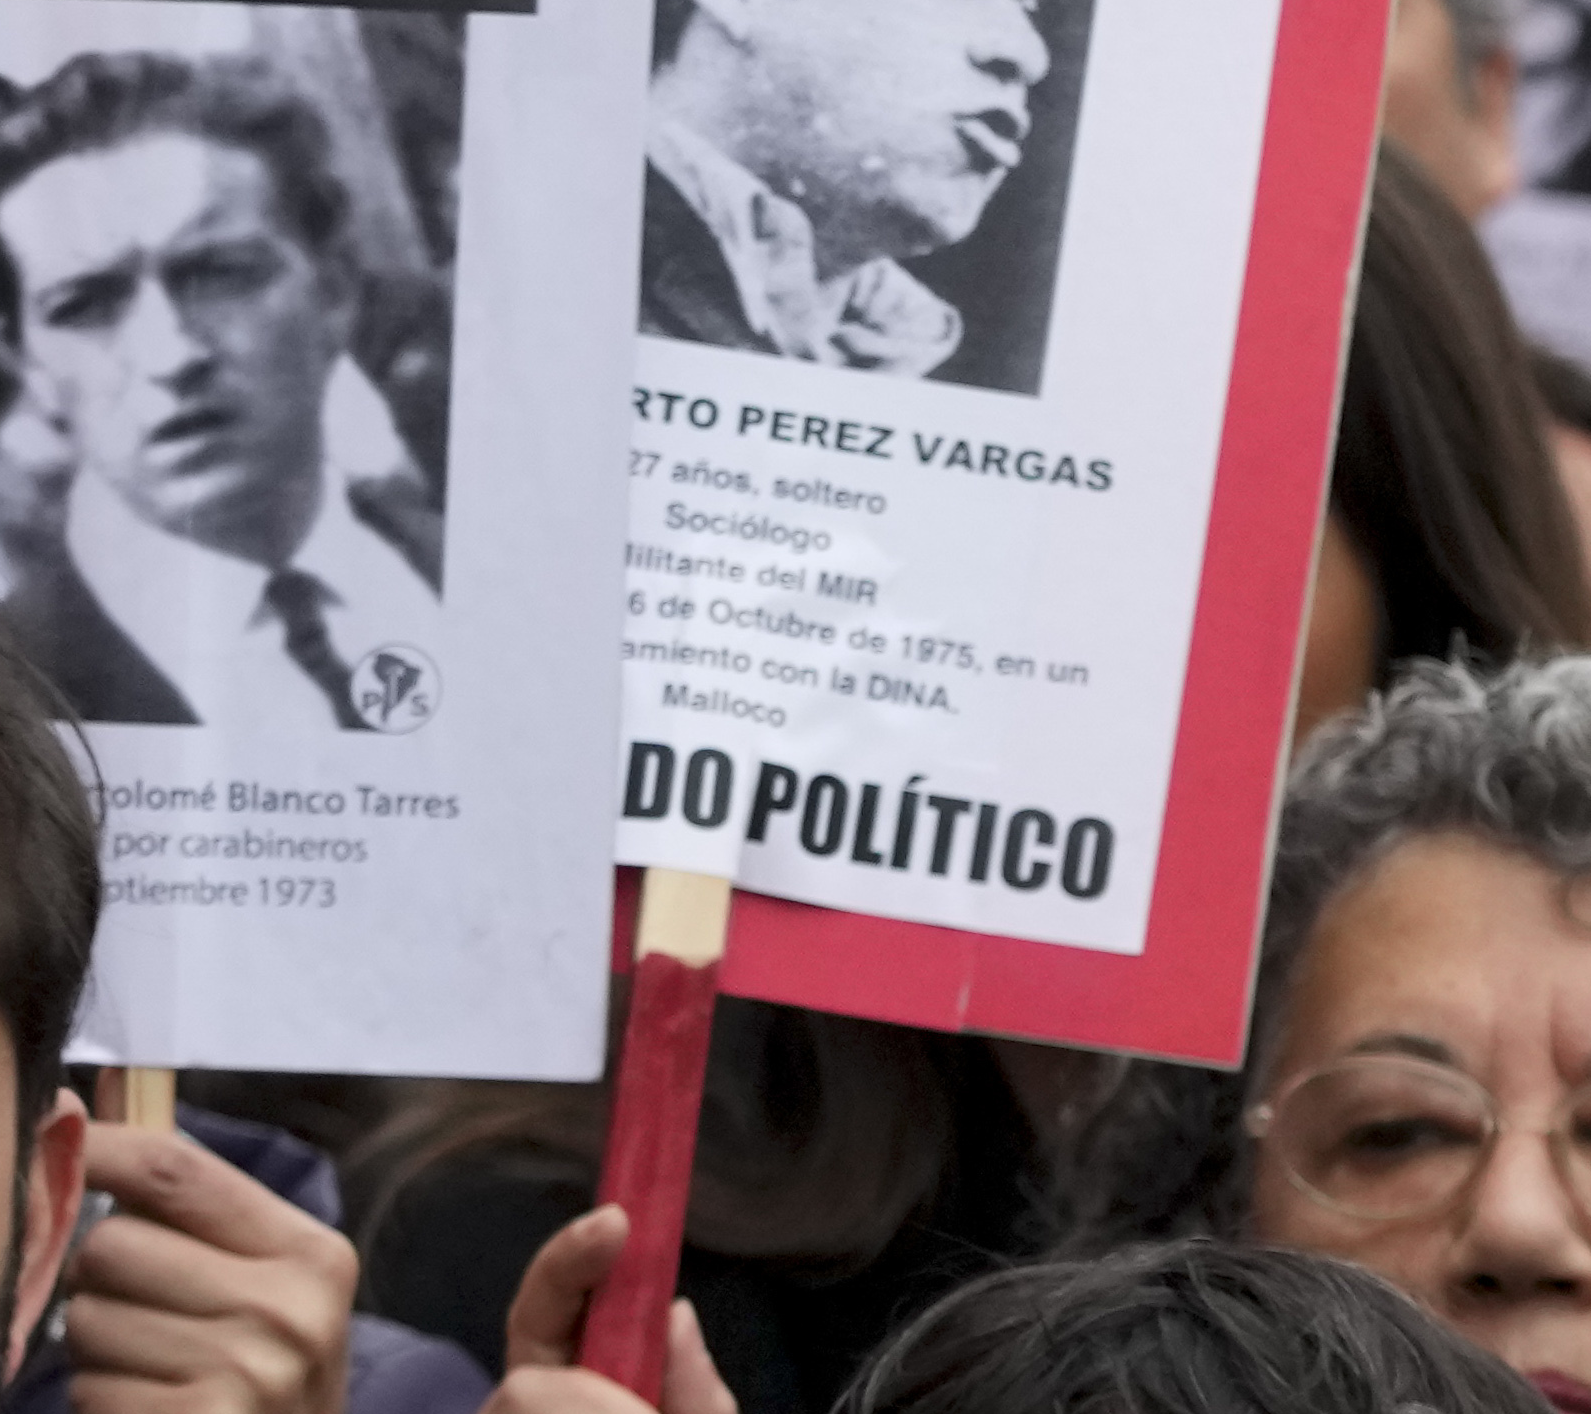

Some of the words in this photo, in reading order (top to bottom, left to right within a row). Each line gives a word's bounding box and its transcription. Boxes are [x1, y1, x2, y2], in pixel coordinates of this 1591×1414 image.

[736, 404, 896, 460] PEREZ
[913, 431, 1117, 493] VARGAS
[670, 458, 761, 498] años,
[770, 477, 889, 517] soltero
[664, 501, 833, 553] Sociólogo
[756, 563, 806, 593] del
[817, 571, 879, 607] MIR
[657, 593, 696, 621] de
[707, 597, 837, 647] Octubre
[847, 627, 889, 656] de
[900, 633, 985, 676] 1975,
[994, 653, 1038, 679] en
[1046, 661, 1090, 687] un
[660, 681, 788, 730] Malloco
[759, 656, 819, 689] con
[829, 665, 857, 697] la
[865, 673, 961, 717] DINA.
[226, 779, 347, 817] Blanco
[355, 782, 463, 821] Tarres
[112, 831, 171, 865] por
[179, 827, 371, 866] carabineros
[745, 761, 1114, 902] POLÍTICO
[260, 877, 338, 910] 1973
